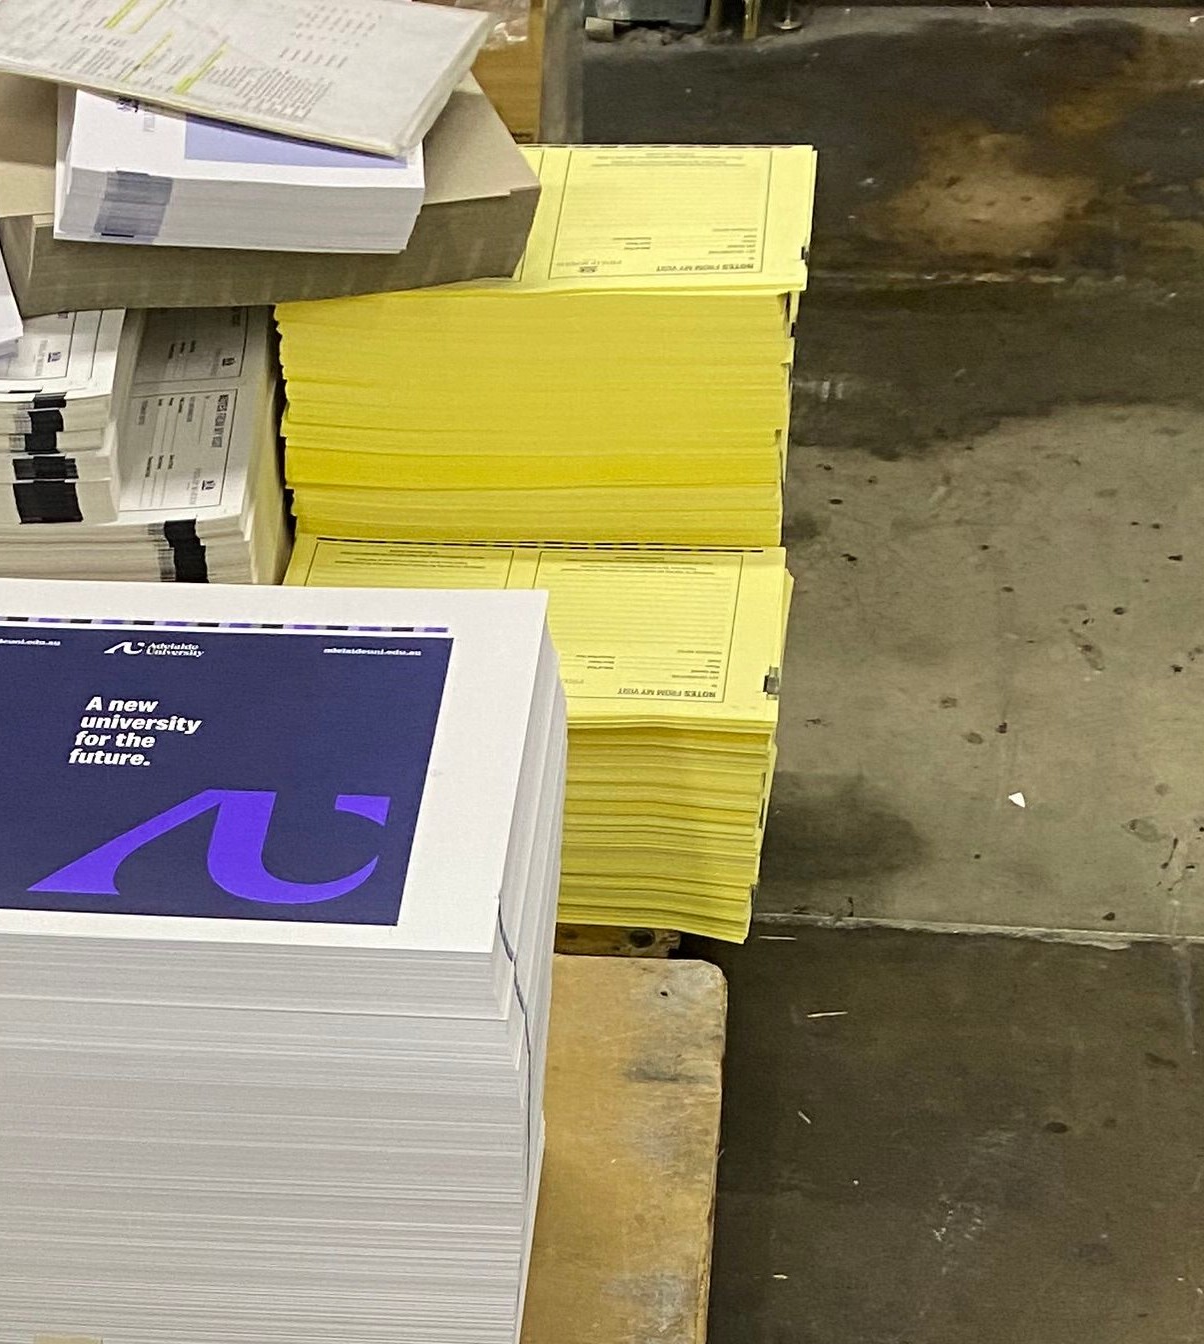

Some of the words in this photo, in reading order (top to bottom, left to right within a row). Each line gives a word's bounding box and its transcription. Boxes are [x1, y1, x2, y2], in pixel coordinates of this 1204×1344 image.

[85, 696, 103, 711] A
[108, 700, 159, 712] new
[80, 714, 203, 734] university
[75, 731, 111, 746] for
[116, 732, 156, 748] the
[69, 748, 150, 766] future.
